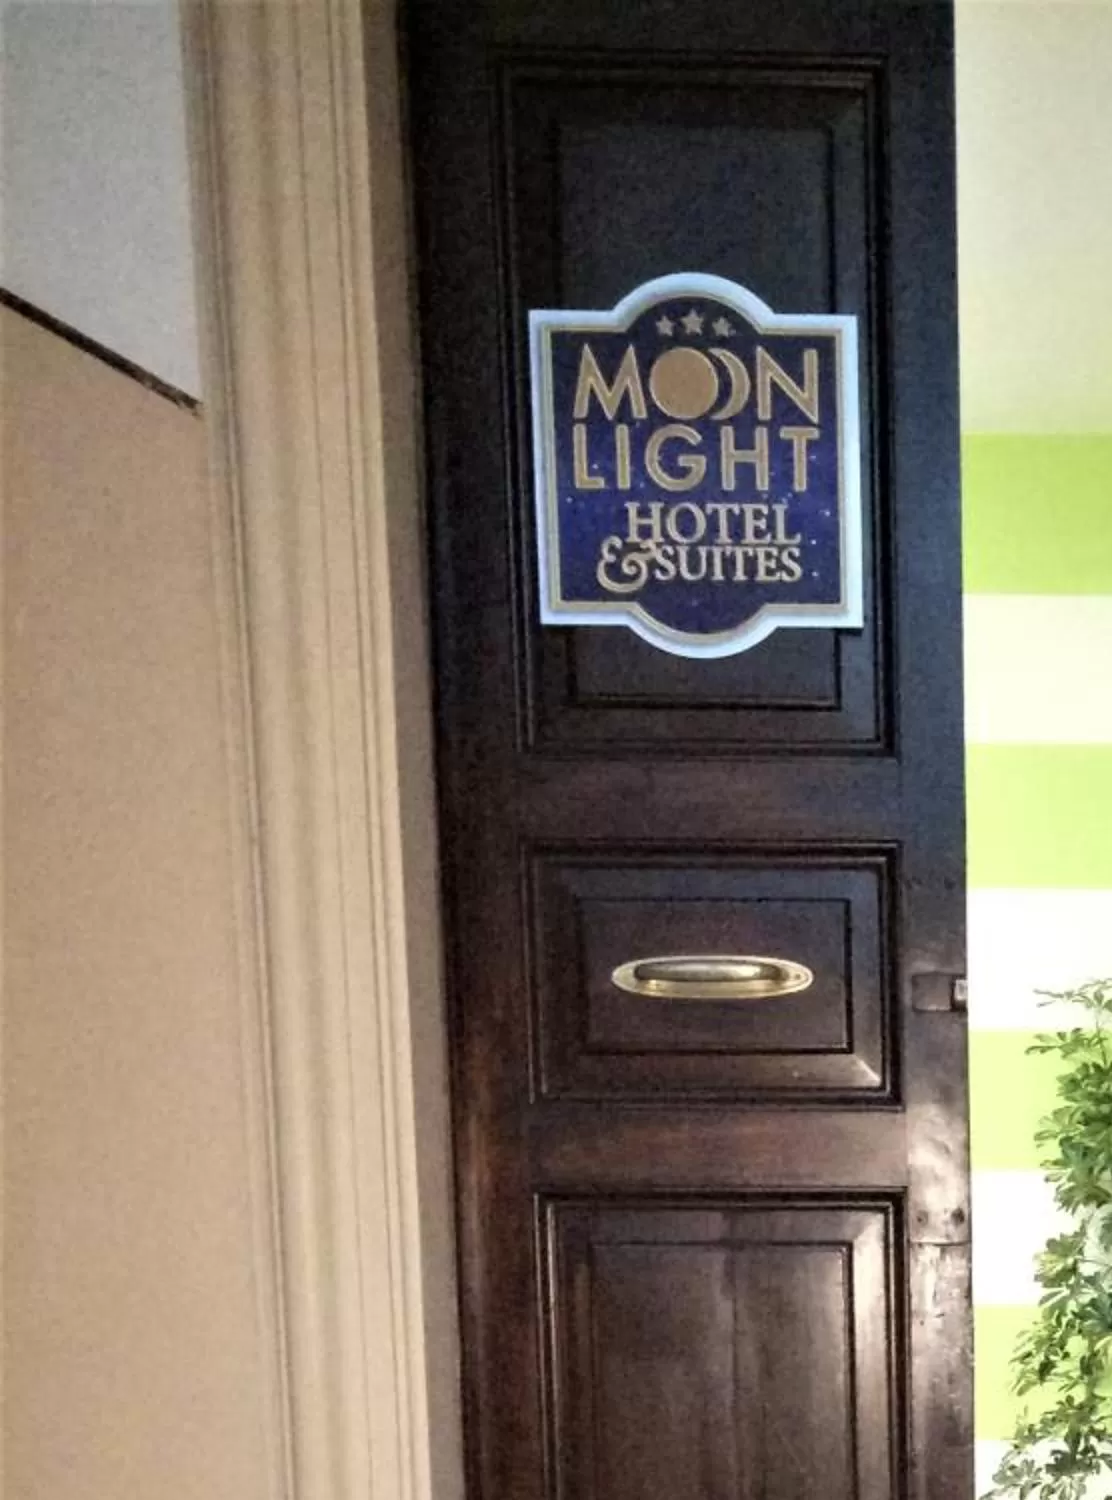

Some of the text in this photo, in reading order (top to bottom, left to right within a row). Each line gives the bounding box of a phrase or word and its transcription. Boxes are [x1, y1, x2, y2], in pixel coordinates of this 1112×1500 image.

[573, 343, 819, 423] MOON
[572, 423, 820, 492] LIGHT
[624, 502, 802, 544] HOTEL
